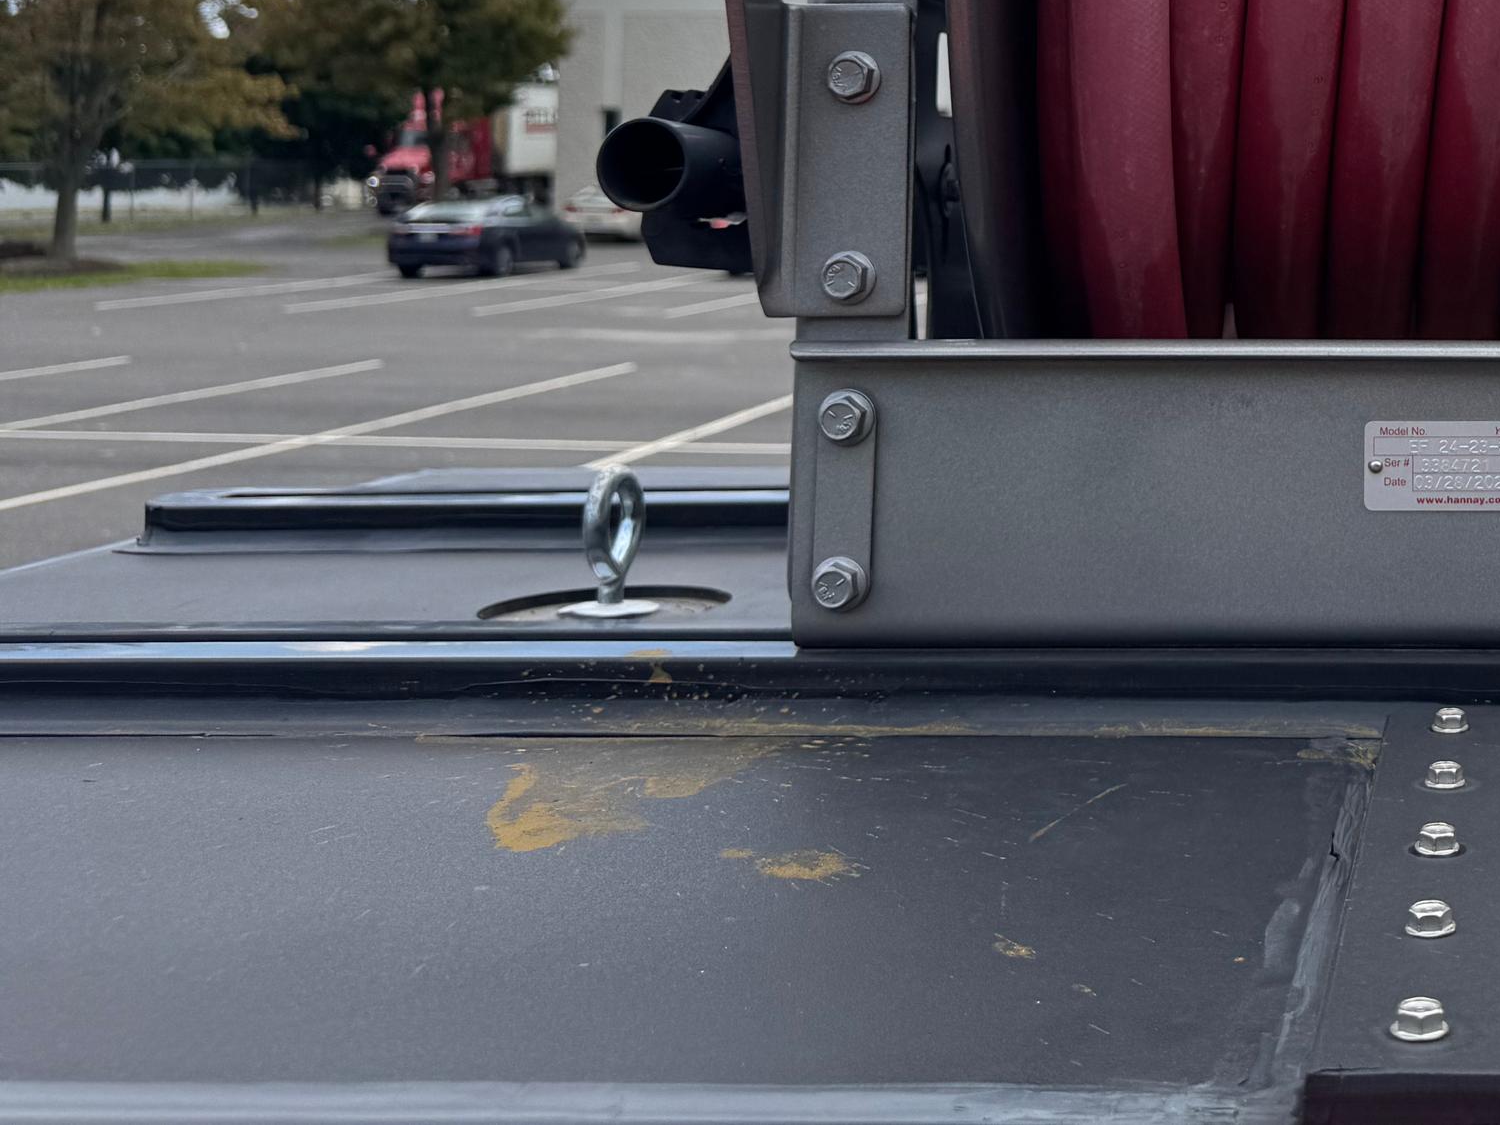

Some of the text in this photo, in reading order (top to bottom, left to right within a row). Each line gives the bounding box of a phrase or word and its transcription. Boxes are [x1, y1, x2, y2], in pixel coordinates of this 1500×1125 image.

[1379, 426, 1428, 436] Model No.
[1384, 458, 1401, 468] Ser
[1402, 458, 1410, 468] #
[1383, 477, 1407, 487] Date
